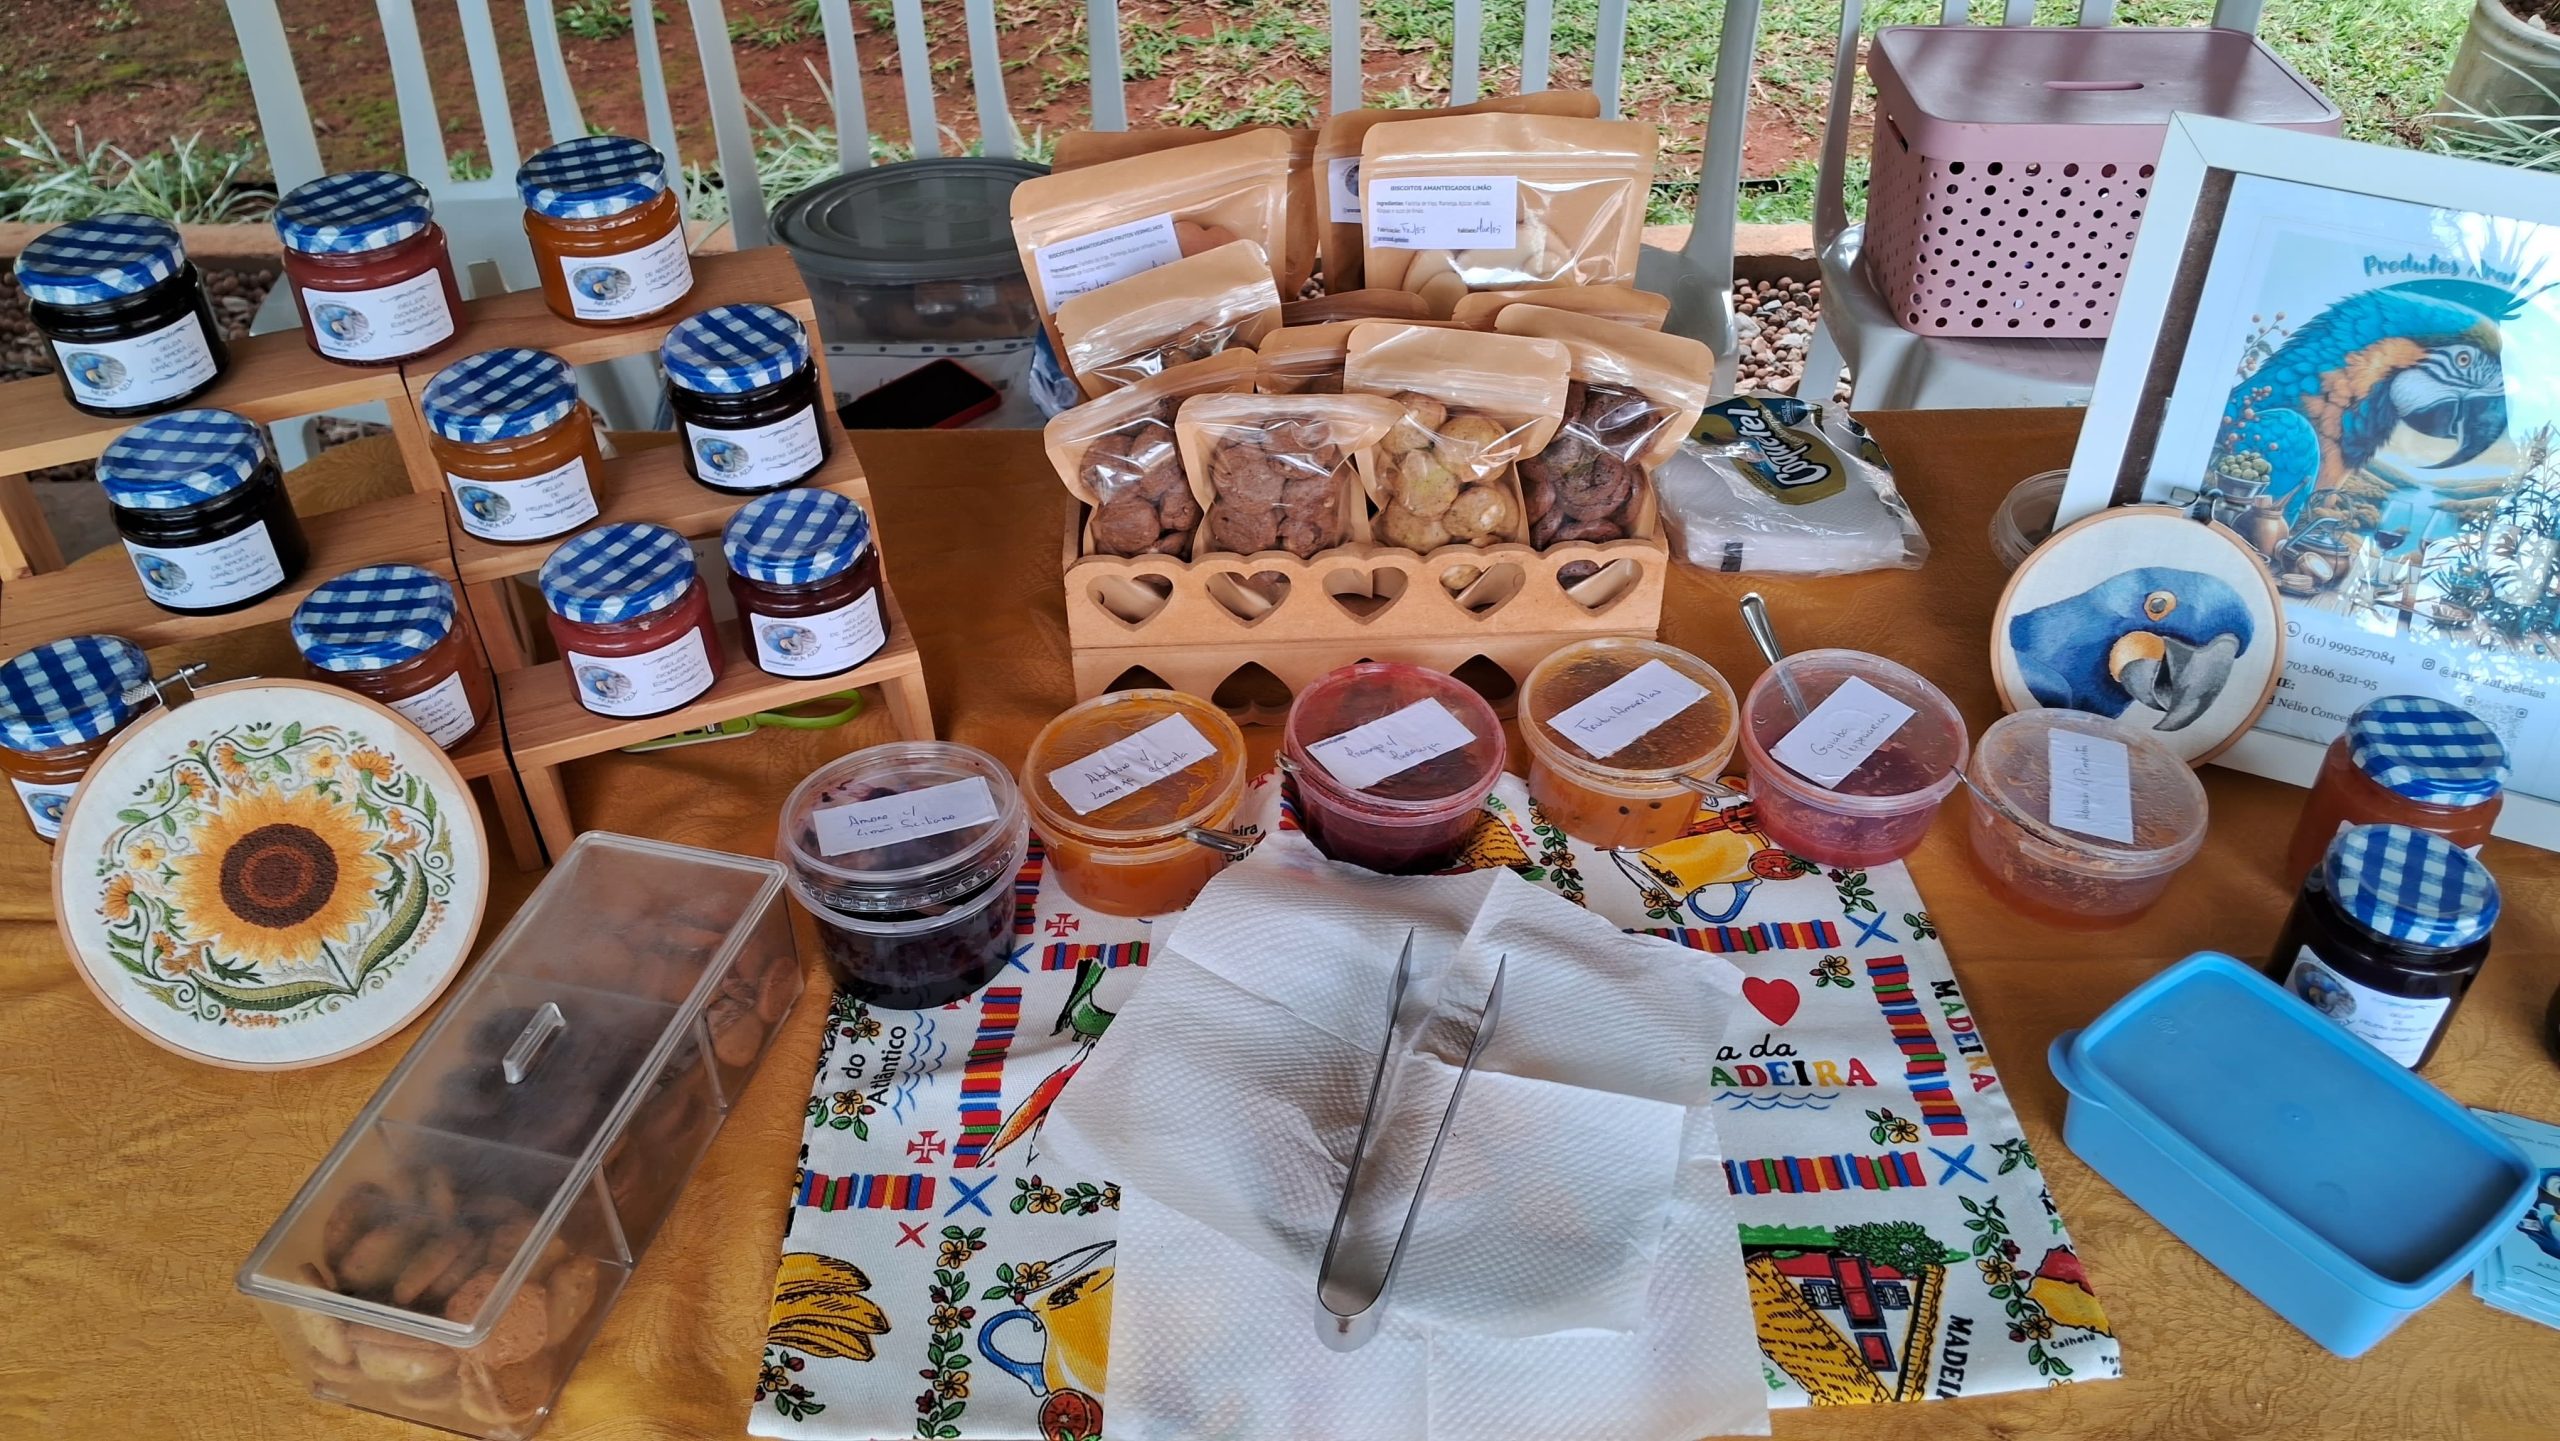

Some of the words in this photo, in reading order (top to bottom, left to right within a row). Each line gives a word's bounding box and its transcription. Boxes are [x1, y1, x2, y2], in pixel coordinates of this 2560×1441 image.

[1472, 183, 1492, 192] LIMÃO
[1727, 407, 1830, 486] Coquetel
[2302, 632, 2327, 649] (61)
[2328, 641, 2396, 665] 999527084
[2276, 697, 2309, 714] Nélio
[1748, 1033, 1798, 1059] da
[1930, 979, 1997, 1093] MADEIRA
[841, 1053, 866, 1080] do
[866, 1026, 907, 1107] Atlântico
[1710, 1057, 1878, 1088] ADEIRA
